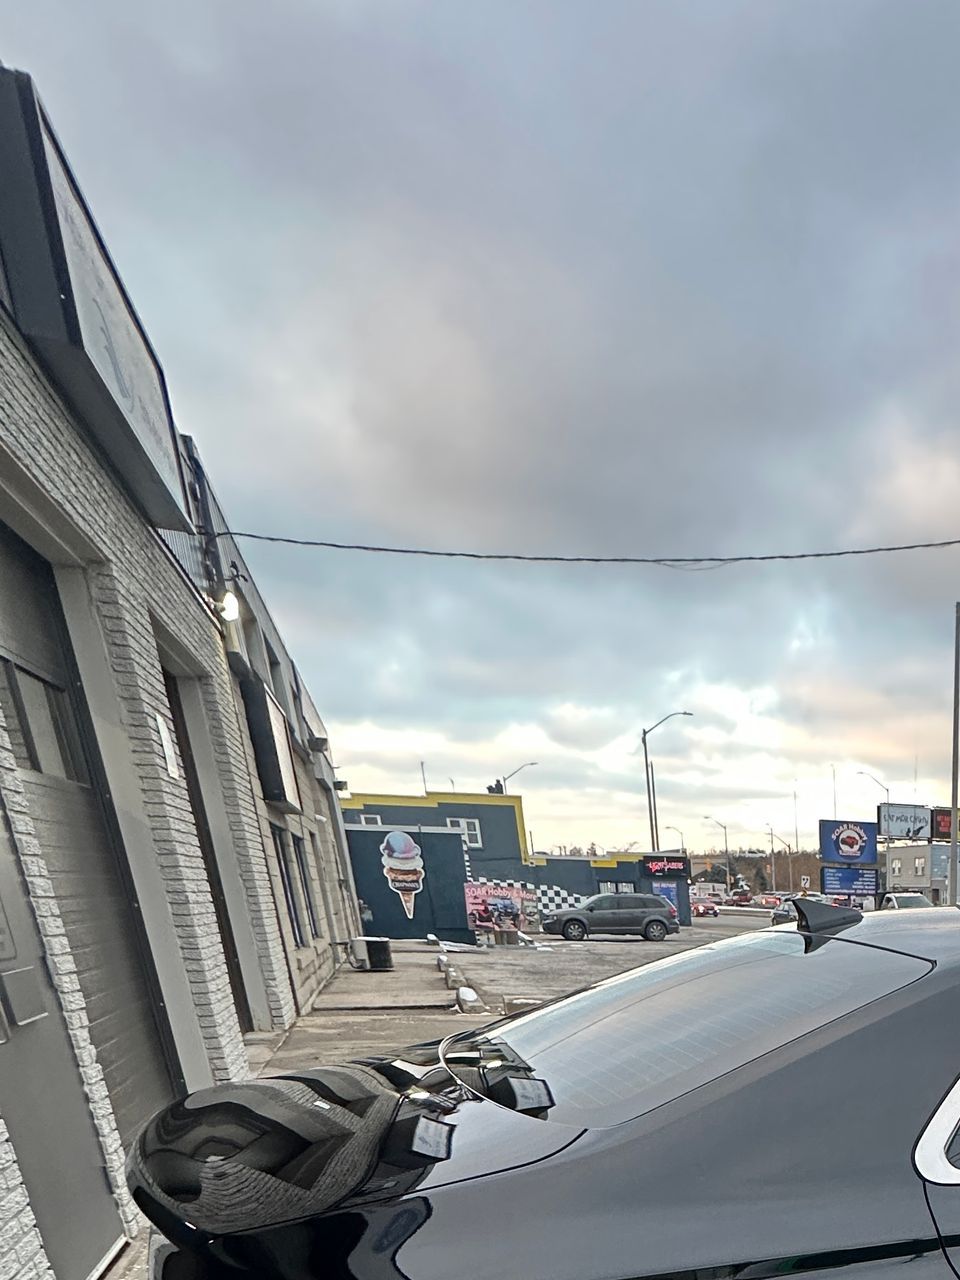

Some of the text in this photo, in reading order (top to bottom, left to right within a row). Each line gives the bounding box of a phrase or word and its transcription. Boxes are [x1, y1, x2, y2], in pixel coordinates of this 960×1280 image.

[465, 887, 487, 897] SOAR
[487, 887, 511, 898] Hobby
[520, 890, 537, 901] More
